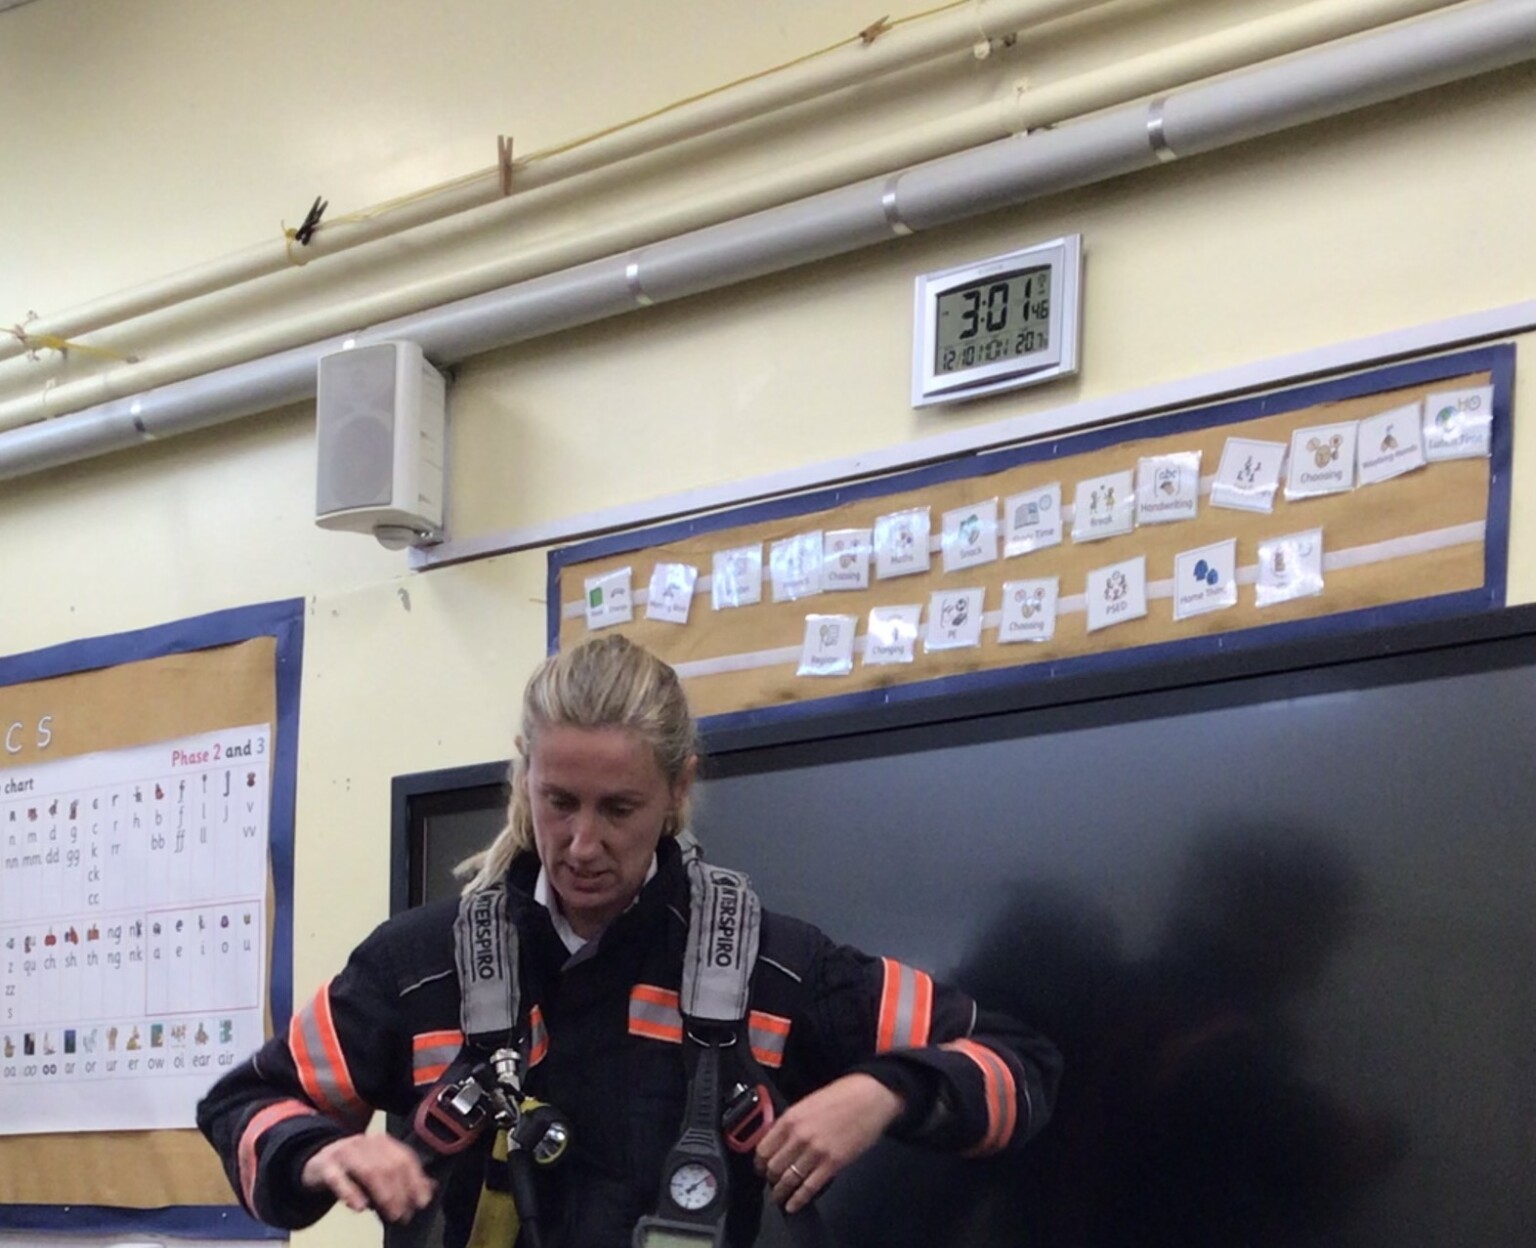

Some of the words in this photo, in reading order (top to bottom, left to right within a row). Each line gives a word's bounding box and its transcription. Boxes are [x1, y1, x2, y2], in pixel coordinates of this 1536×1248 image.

[1299, 468, 1344, 485] Choosing
[1140, 499, 1193, 514] Handwriting
[827, 570, 862, 583] Choosing
[171, 750, 210, 767] Phase
[213, 743, 222, 760] 2
[225, 739, 252, 758] and
[256, 737, 265, 755] 3
[4, 777, 34, 794] chart
